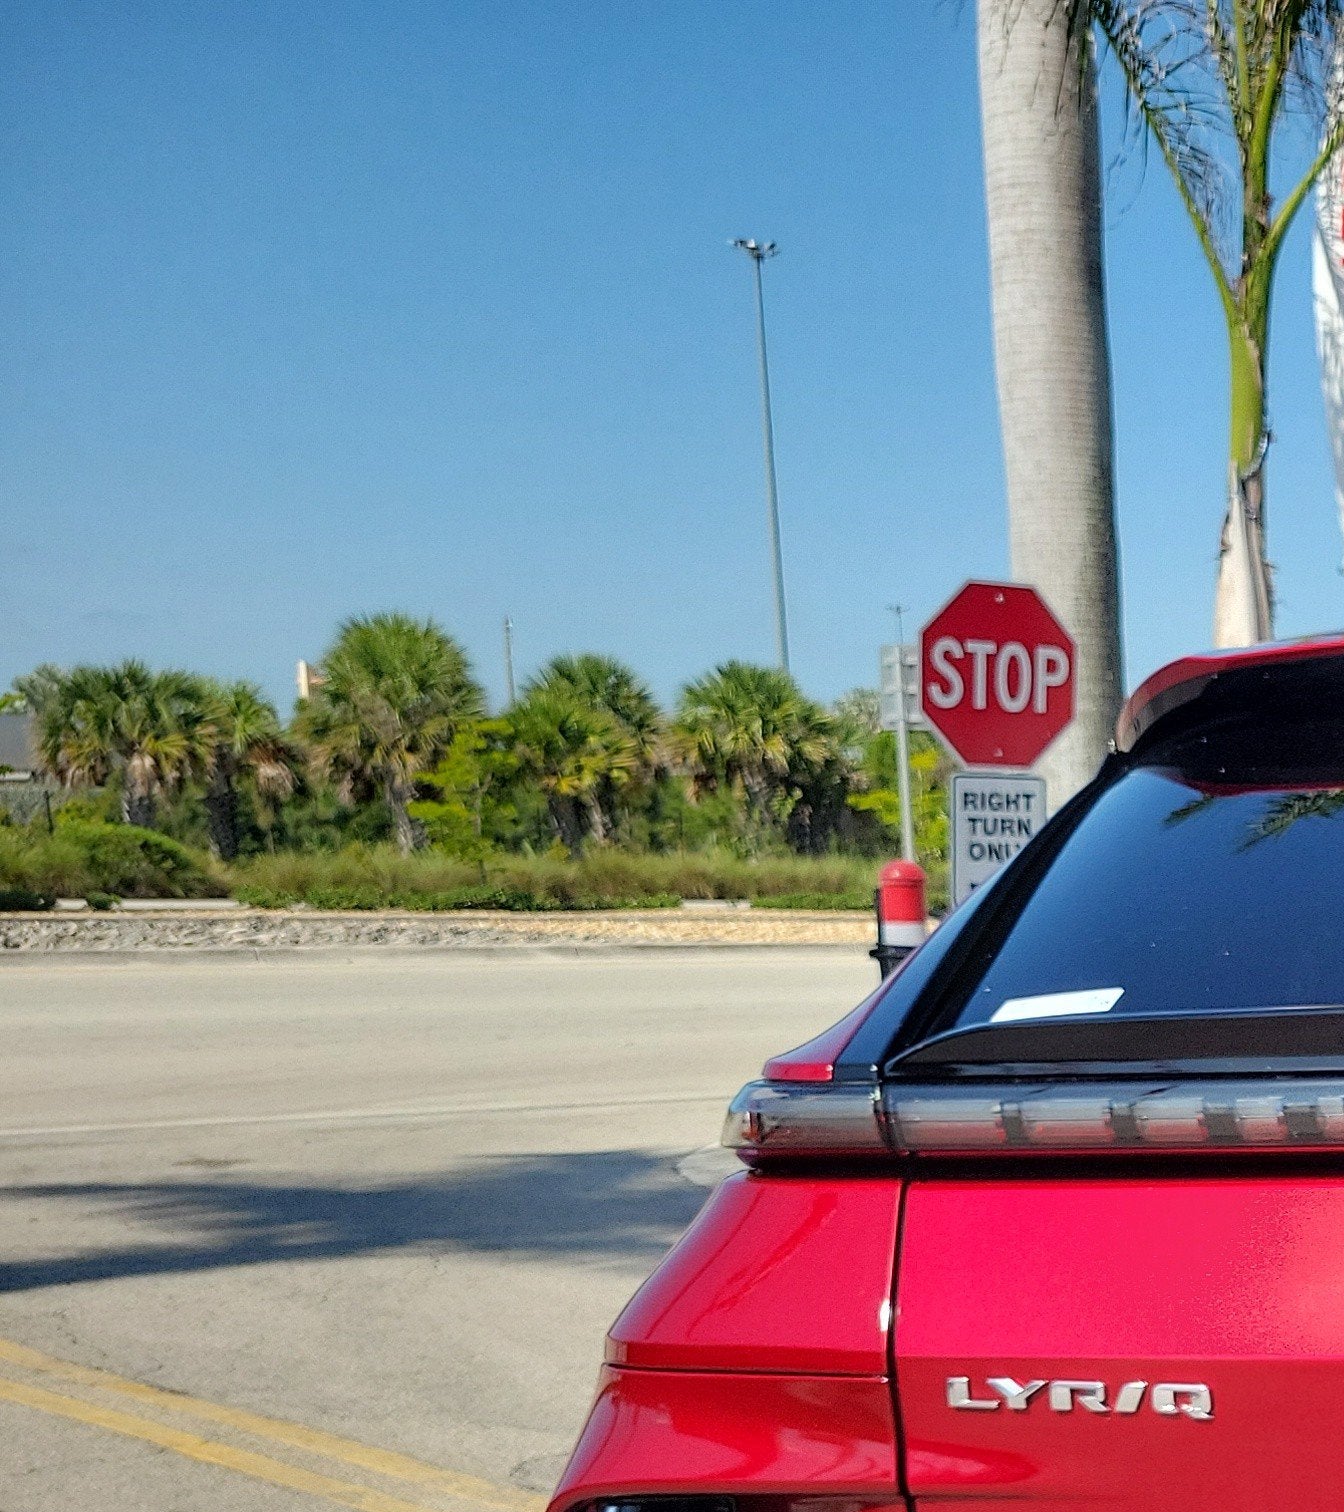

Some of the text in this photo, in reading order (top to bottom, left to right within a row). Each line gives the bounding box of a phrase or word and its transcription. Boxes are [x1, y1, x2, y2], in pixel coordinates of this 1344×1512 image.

[927, 635, 1071, 715] STOP
[963, 791, 1037, 812] RIGHT
[967, 817, 1032, 836] TURN
[969, 842, 1020, 862] ONL
